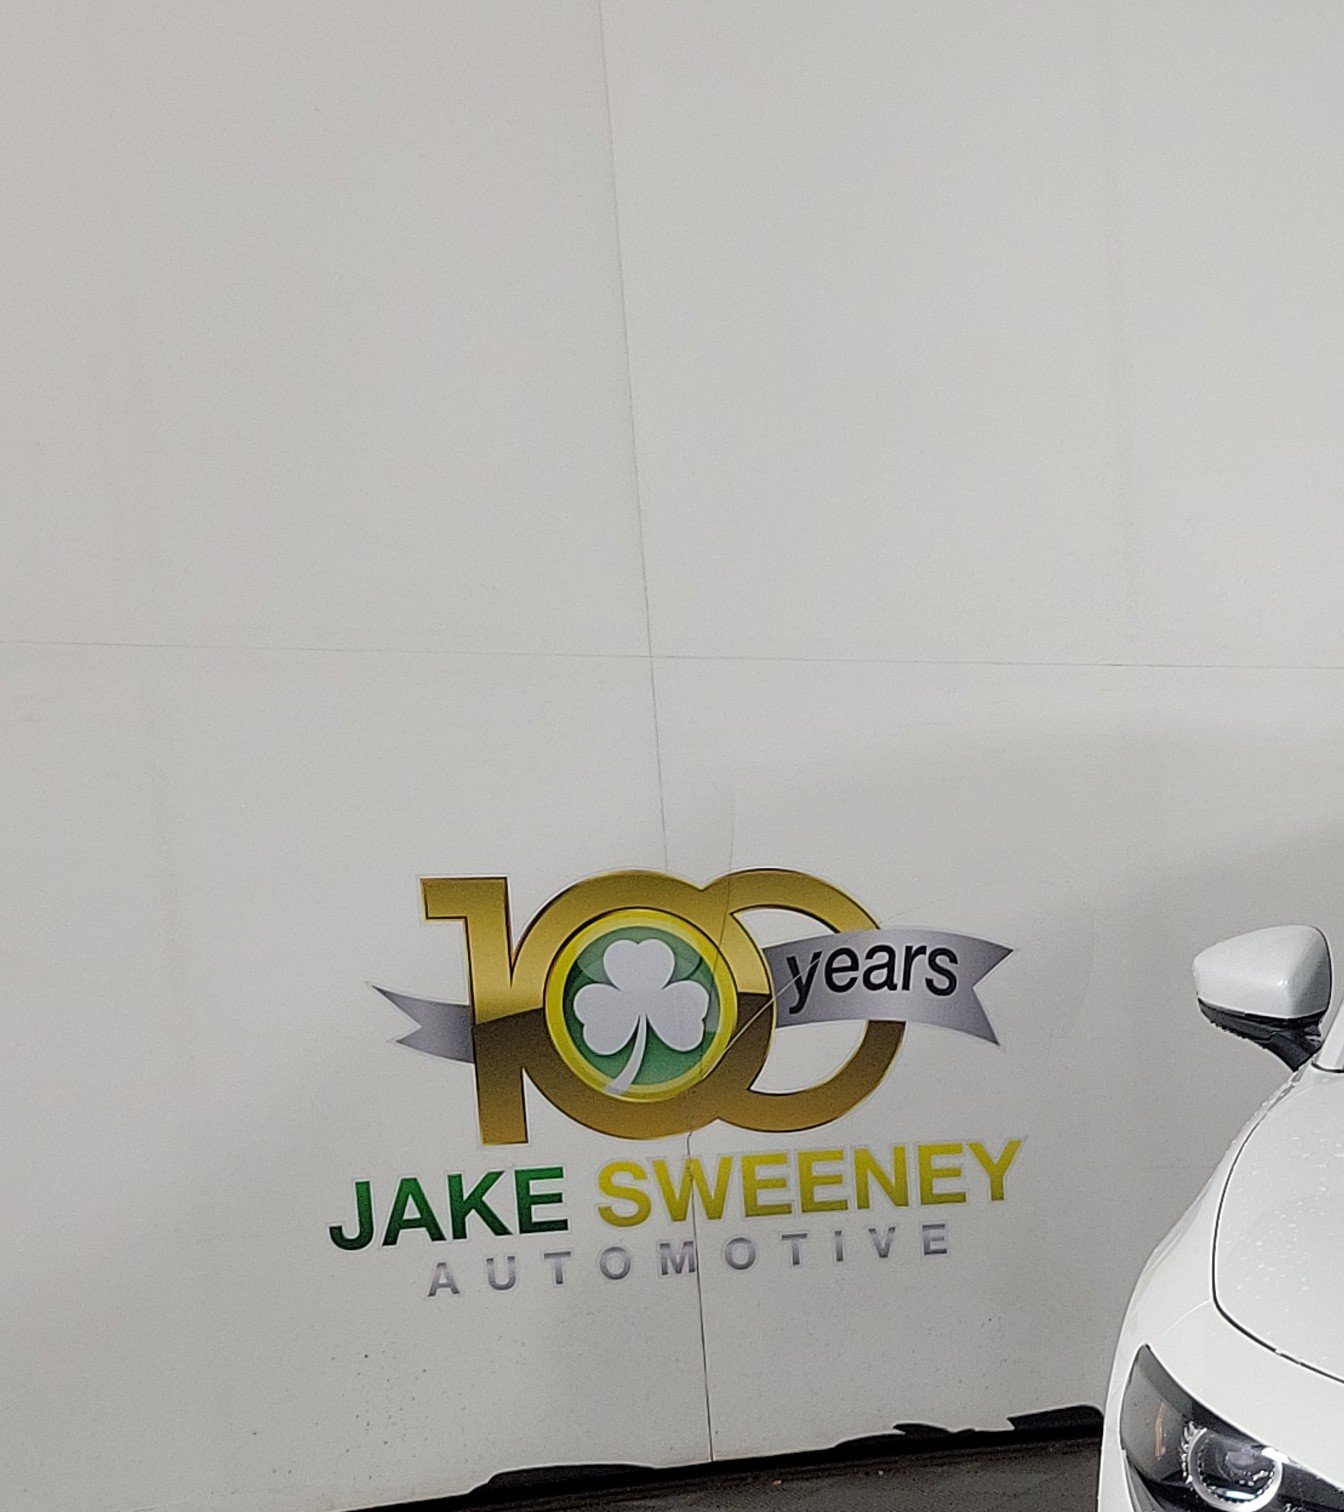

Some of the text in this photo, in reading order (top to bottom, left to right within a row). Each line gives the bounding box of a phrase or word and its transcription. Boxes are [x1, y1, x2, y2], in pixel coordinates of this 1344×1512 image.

[419, 867, 957, 1145] 100 years
[329, 1140, 1022, 1250] JAKE SWEENEY
[428, 1223, 948, 1297] AUTOMOTIVE
